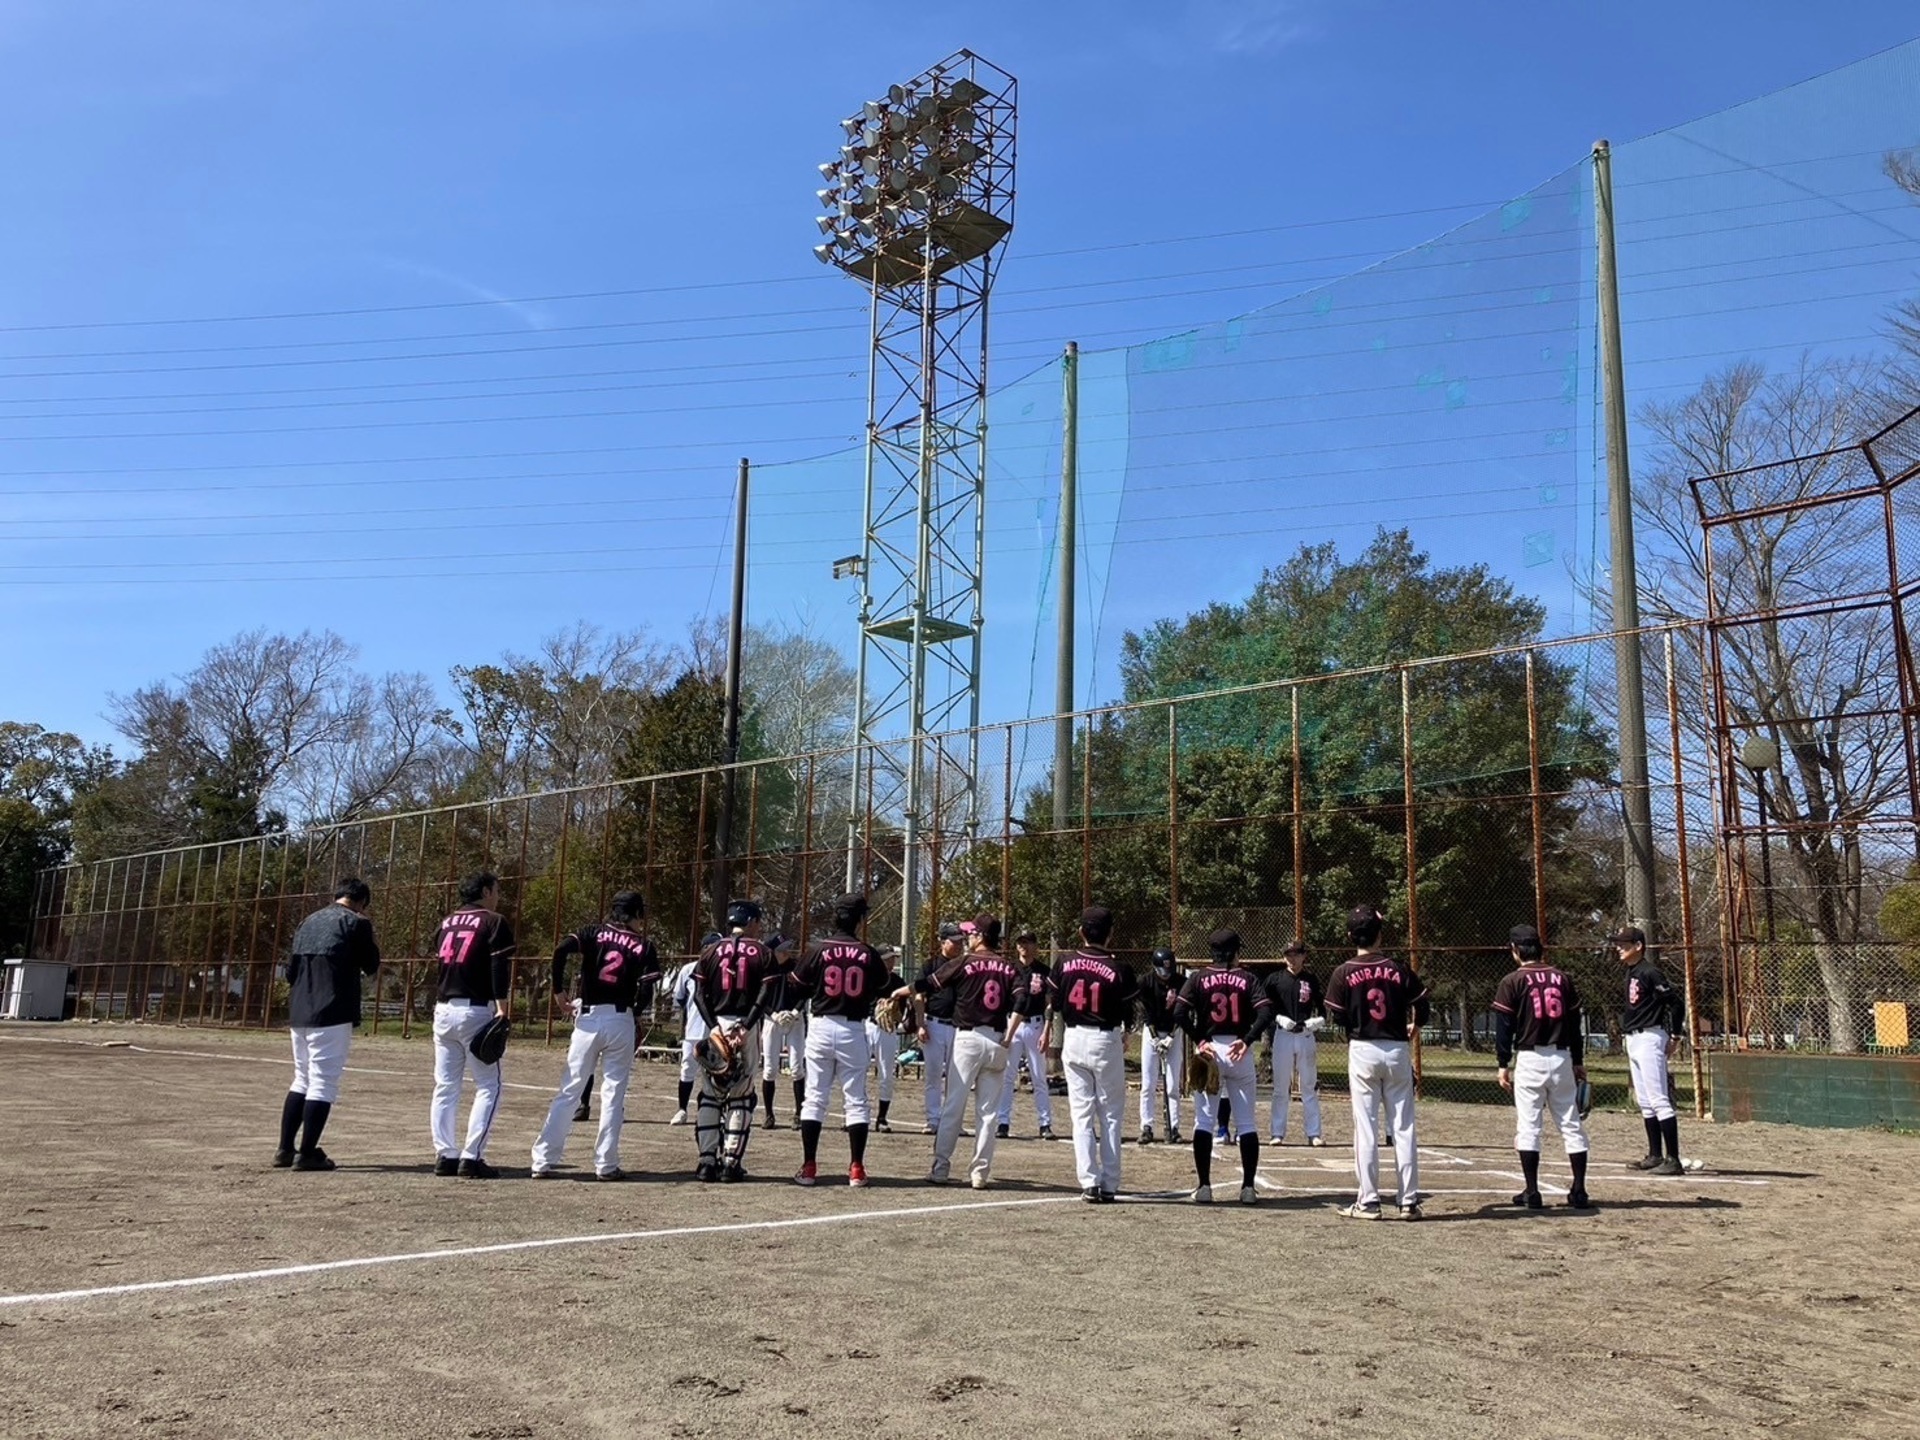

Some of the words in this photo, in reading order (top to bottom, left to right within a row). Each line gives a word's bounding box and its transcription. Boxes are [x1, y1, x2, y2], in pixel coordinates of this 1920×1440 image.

[442, 914, 480, 930] KEITA
[438, 929, 476, 964] 47
[597, 931, 643, 955] SHINYA
[716, 942, 758, 957] TARO
[822, 947, 867, 963] KUWA
[598, 951, 623, 983] 2
[718, 956, 746, 991] 11
[824, 965, 864, 997] 90
[1063, 958, 1116, 983] MATSUSHITA
[1201, 972, 1247, 991] KATSUYA
[1346, 966, 1401, 987] MURAKA
[1526, 972, 1563, 986] JUN
[983, 979, 1000, 1010] 8
[1068, 978, 1100, 1012] 41
[1210, 992, 1239, 1024] 31
[1367, 988, 1386, 1020] 3
[1529, 986, 1563, 1020] 16
